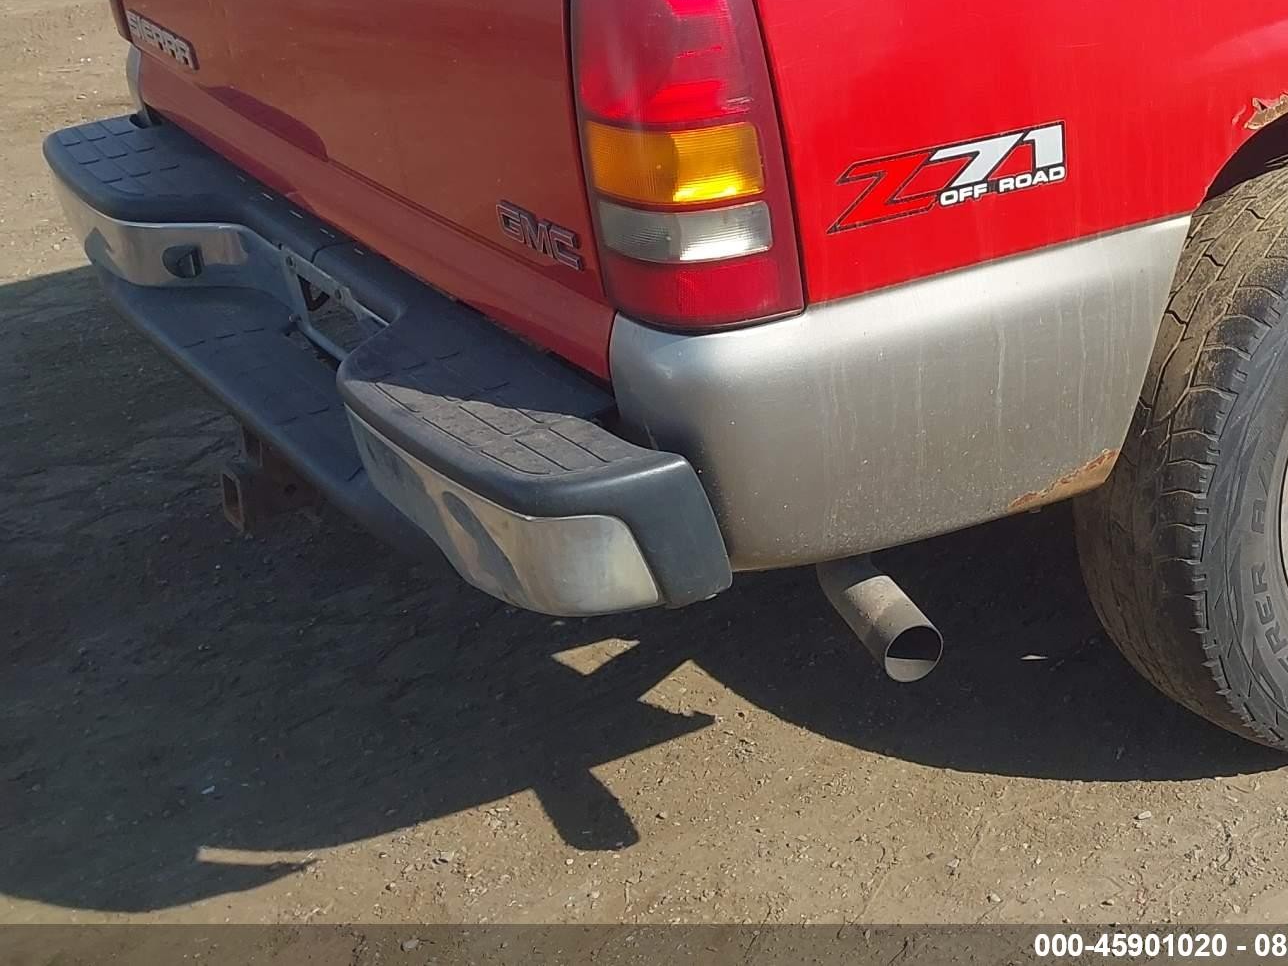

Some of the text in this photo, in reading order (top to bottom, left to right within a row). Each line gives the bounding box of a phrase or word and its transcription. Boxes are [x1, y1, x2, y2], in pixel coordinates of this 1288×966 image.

[126, 10, 195, 70] SIERRA
[827, 121, 1065, 234] Z71
[939, 165, 1067, 207] OFF ROAD
[496, 202, 584, 270] GMC
